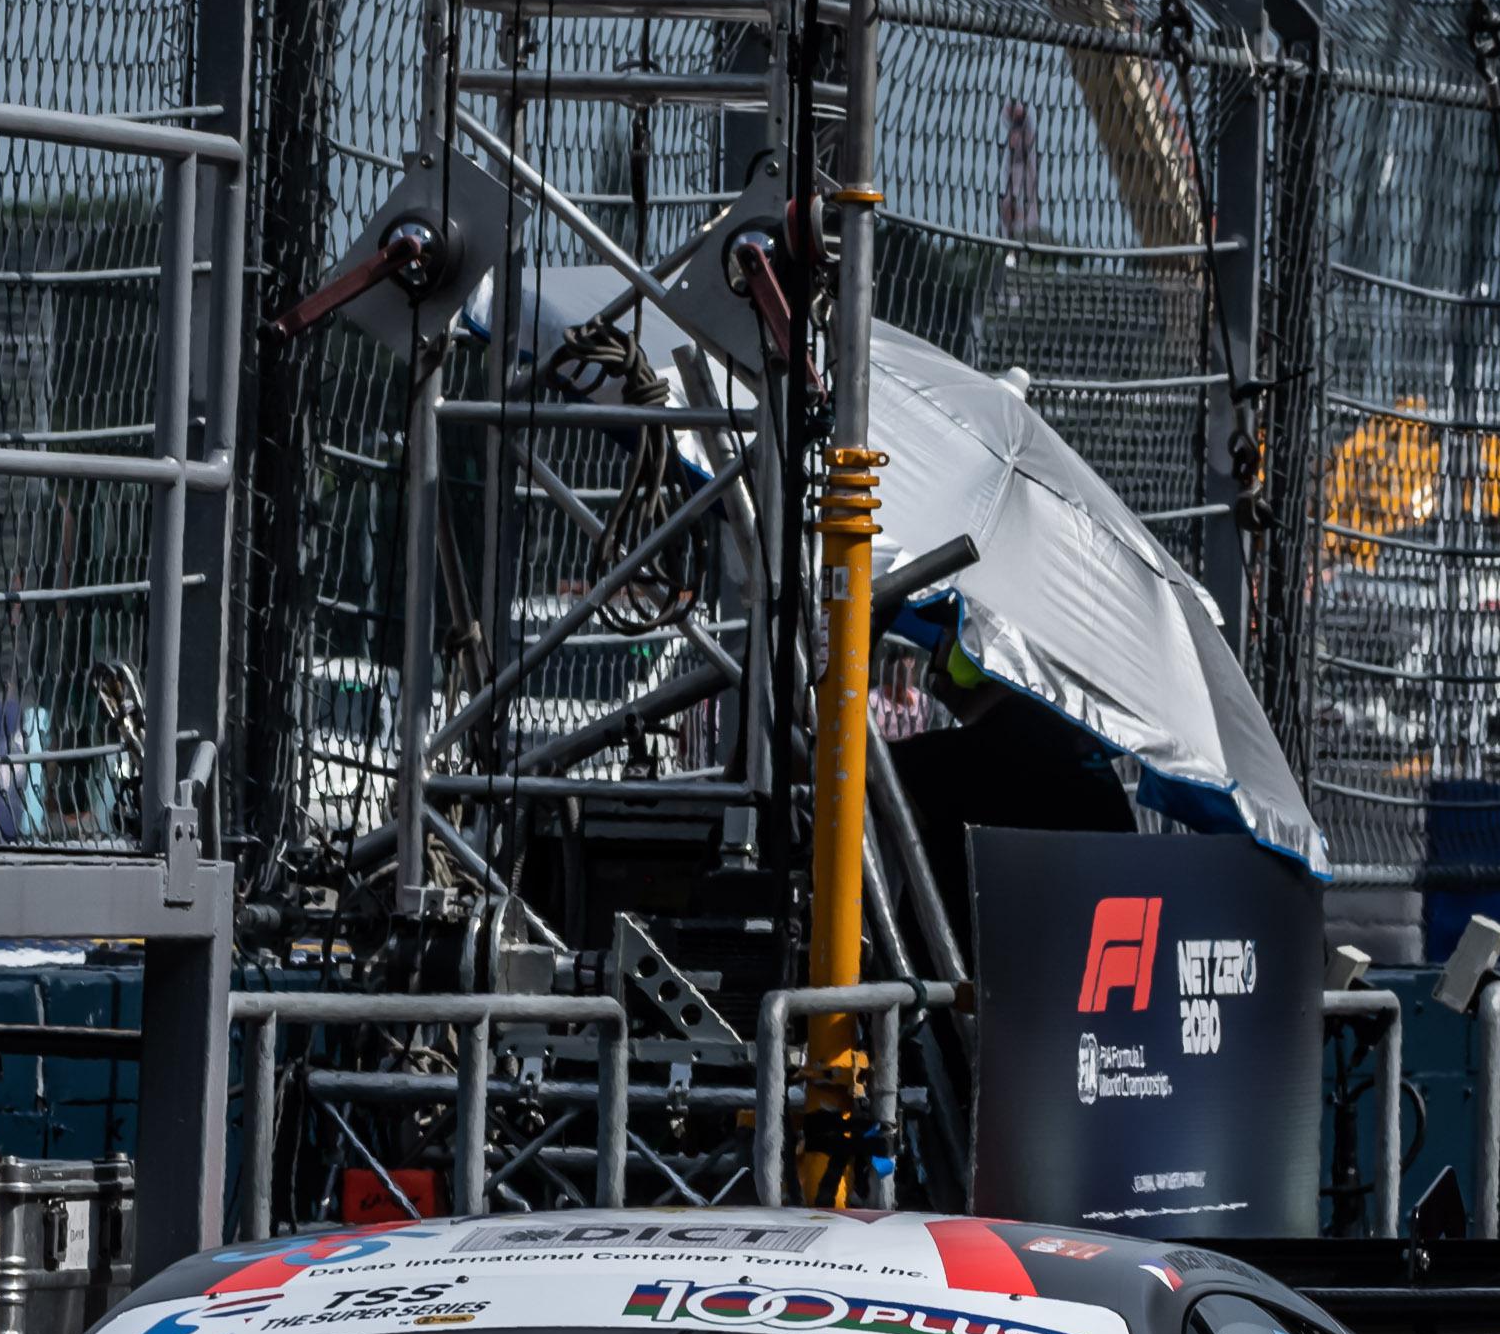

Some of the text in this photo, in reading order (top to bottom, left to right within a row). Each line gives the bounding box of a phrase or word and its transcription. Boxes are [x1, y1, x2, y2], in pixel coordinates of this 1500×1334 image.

[1180, 999, 1222, 1055] 2030
[562, 1225, 791, 1245] DICT
[309, 1262, 396, 1278] Davao
[405, 1251, 584, 1268] International
[594, 1250, 726, 1264] Container
[260, 1300, 492, 1332] THE SUPER SERIES
[324, 1283, 451, 1310] TSS
[650, 1279, 849, 1331] 100
